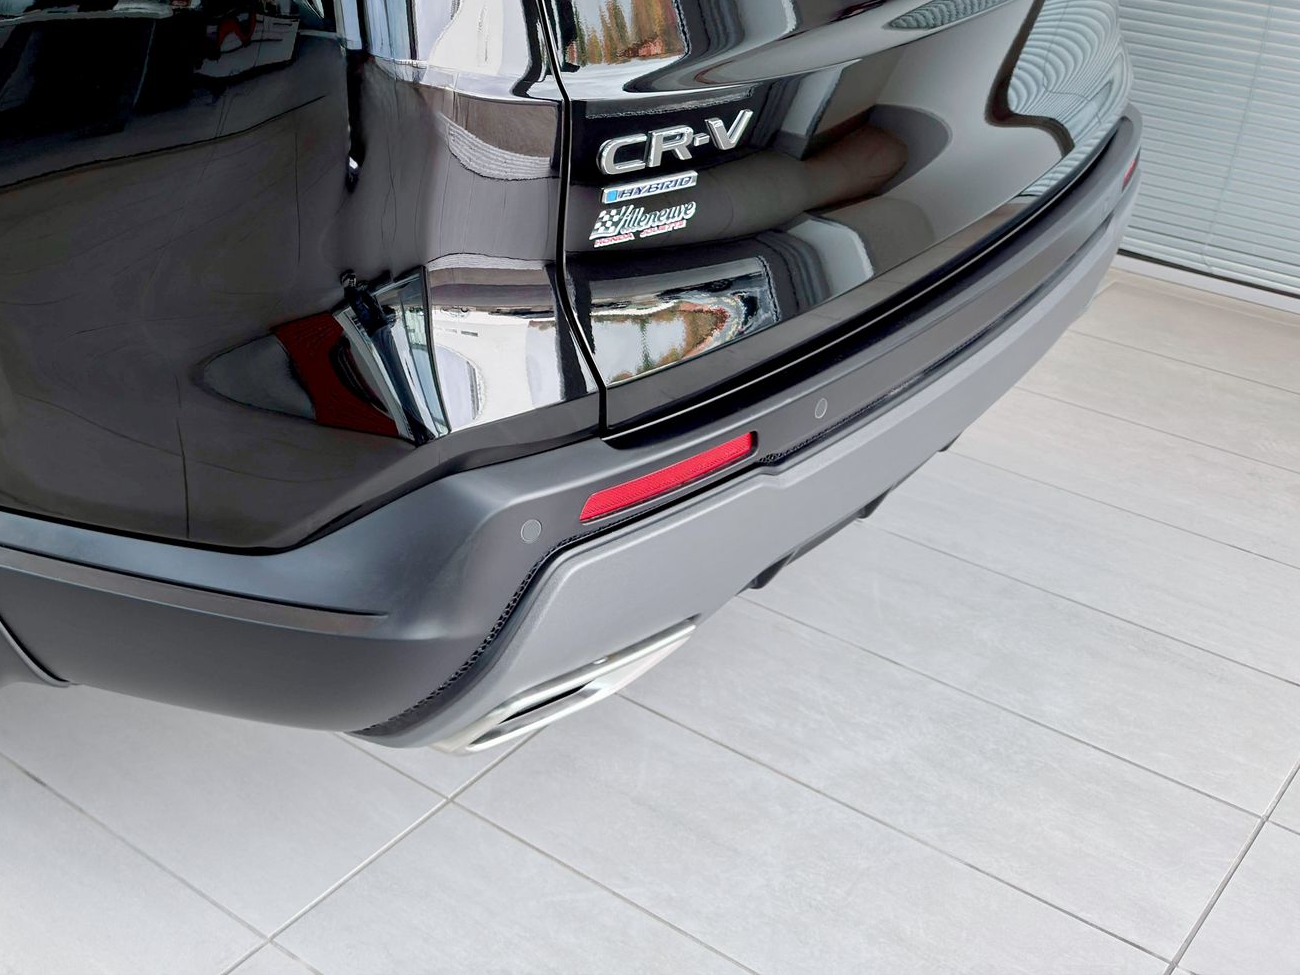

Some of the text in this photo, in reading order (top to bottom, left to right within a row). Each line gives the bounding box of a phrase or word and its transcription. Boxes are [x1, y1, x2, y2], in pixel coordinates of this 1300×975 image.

[596, 109, 753, 175] CR-V
[618, 176, 692, 199] HYBRID
[616, 201, 697, 235] Villeneuve
[595, 232, 635, 247] HONDA
